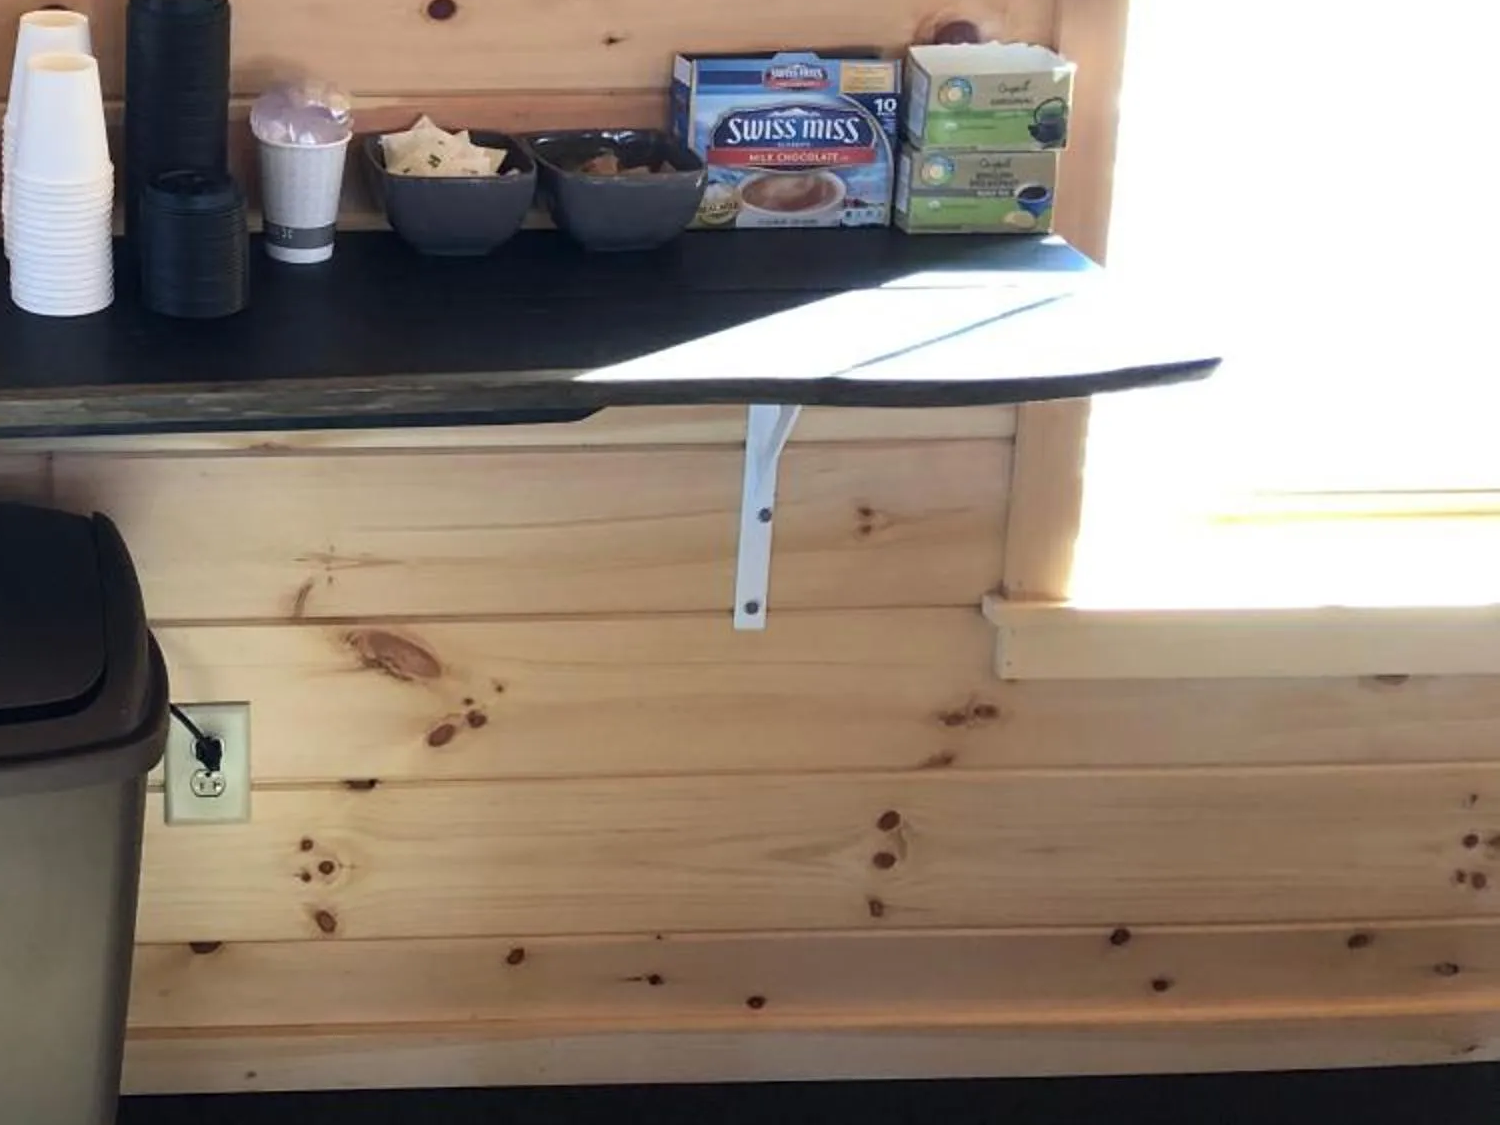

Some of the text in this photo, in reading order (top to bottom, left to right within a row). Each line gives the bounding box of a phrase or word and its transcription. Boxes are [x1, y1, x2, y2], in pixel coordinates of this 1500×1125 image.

[873, 98, 898, 115] 10
[727, 117, 797, 145] SWISS
[749, 152, 774, 162] MILK
[776, 152, 839, 163] CHOCOLATE
